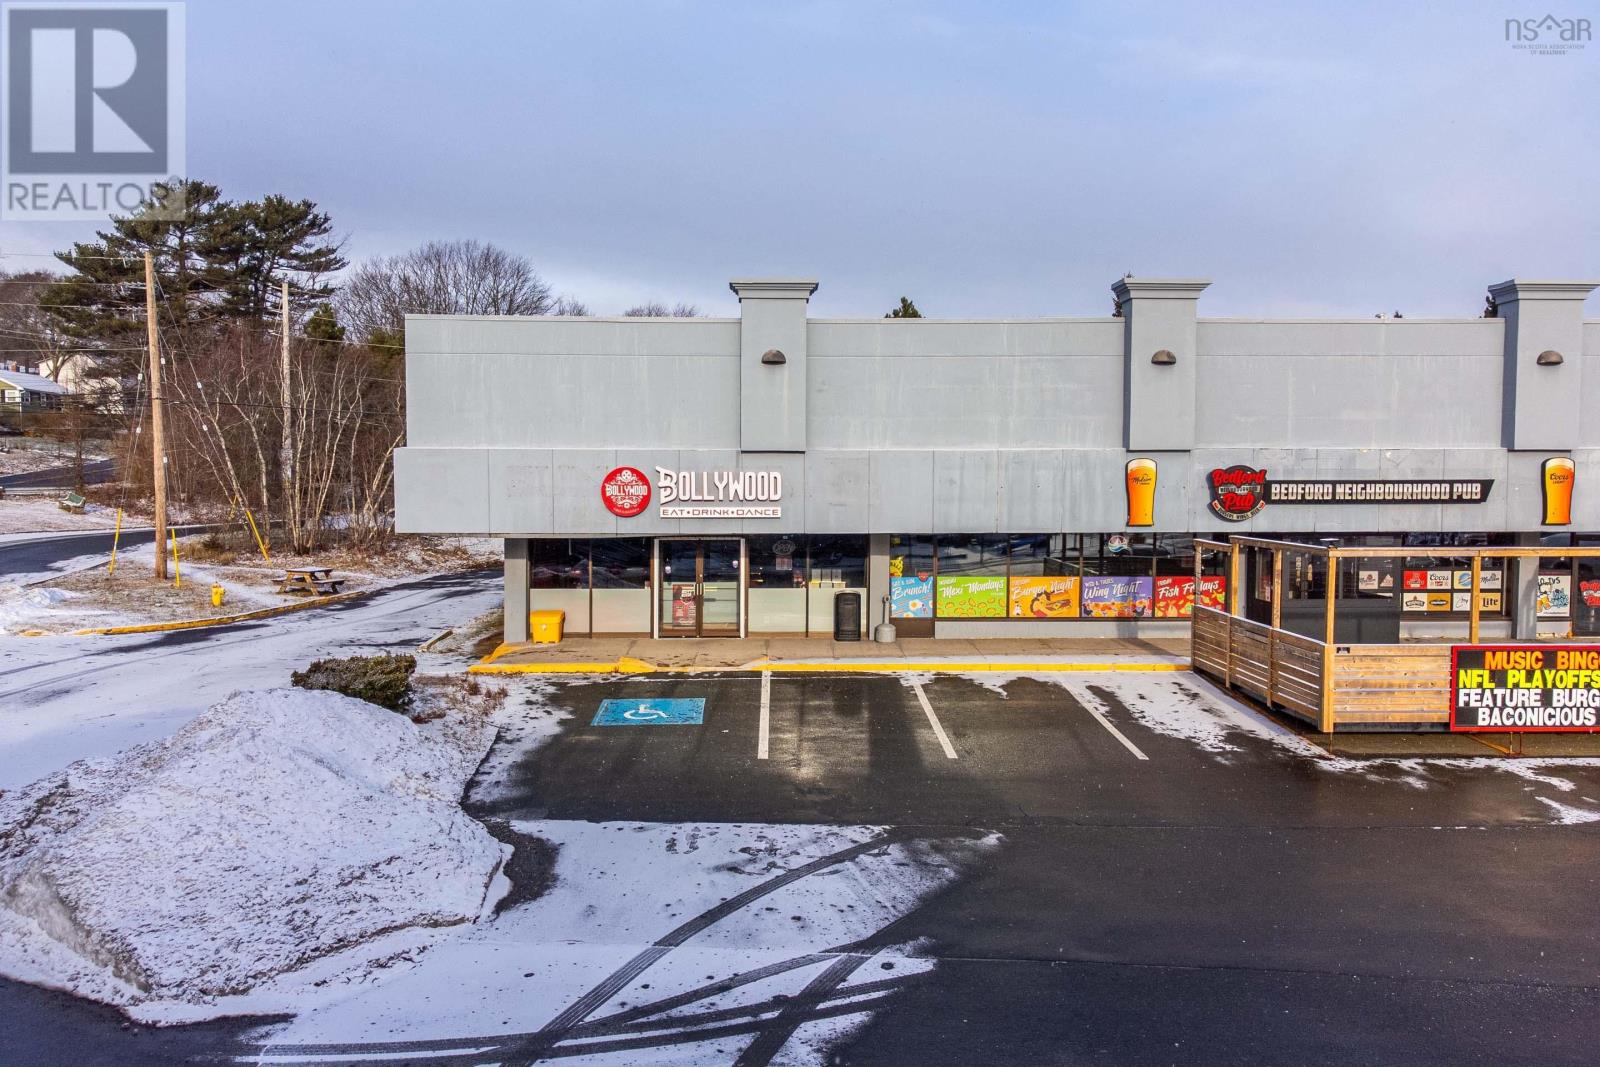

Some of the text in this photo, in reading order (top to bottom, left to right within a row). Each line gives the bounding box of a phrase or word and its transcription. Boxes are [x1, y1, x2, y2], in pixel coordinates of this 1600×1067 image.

[656, 465, 782, 505] BOLLYWOOD
[1211, 467, 1268, 487] Bedford
[604, 483, 648, 497] BOLLYWOOD
[1271, 482, 1482, 500] BEDFORD NEIGHBOURHOOD PUB
[1223, 492, 1256, 512] Pub
[1429, 573, 1449, 582] Coors
[892, 580, 932, 600] Brunch!
[940, 585, 964, 599] Mexi
[964, 579, 1005, 594] Mondays
[1084, 581, 1143, 599] Wing Night
[1158, 585, 1180, 600] Fish
[1483, 597, 1499, 607] Lite
[1484, 651, 1600, 670] MUSIC BING
[1458, 669, 1600, 689] NFL PLAYOFFS
[1458, 688, 1542, 707] FEATURE
[1477, 707, 1597, 726] BACONICIOUS
